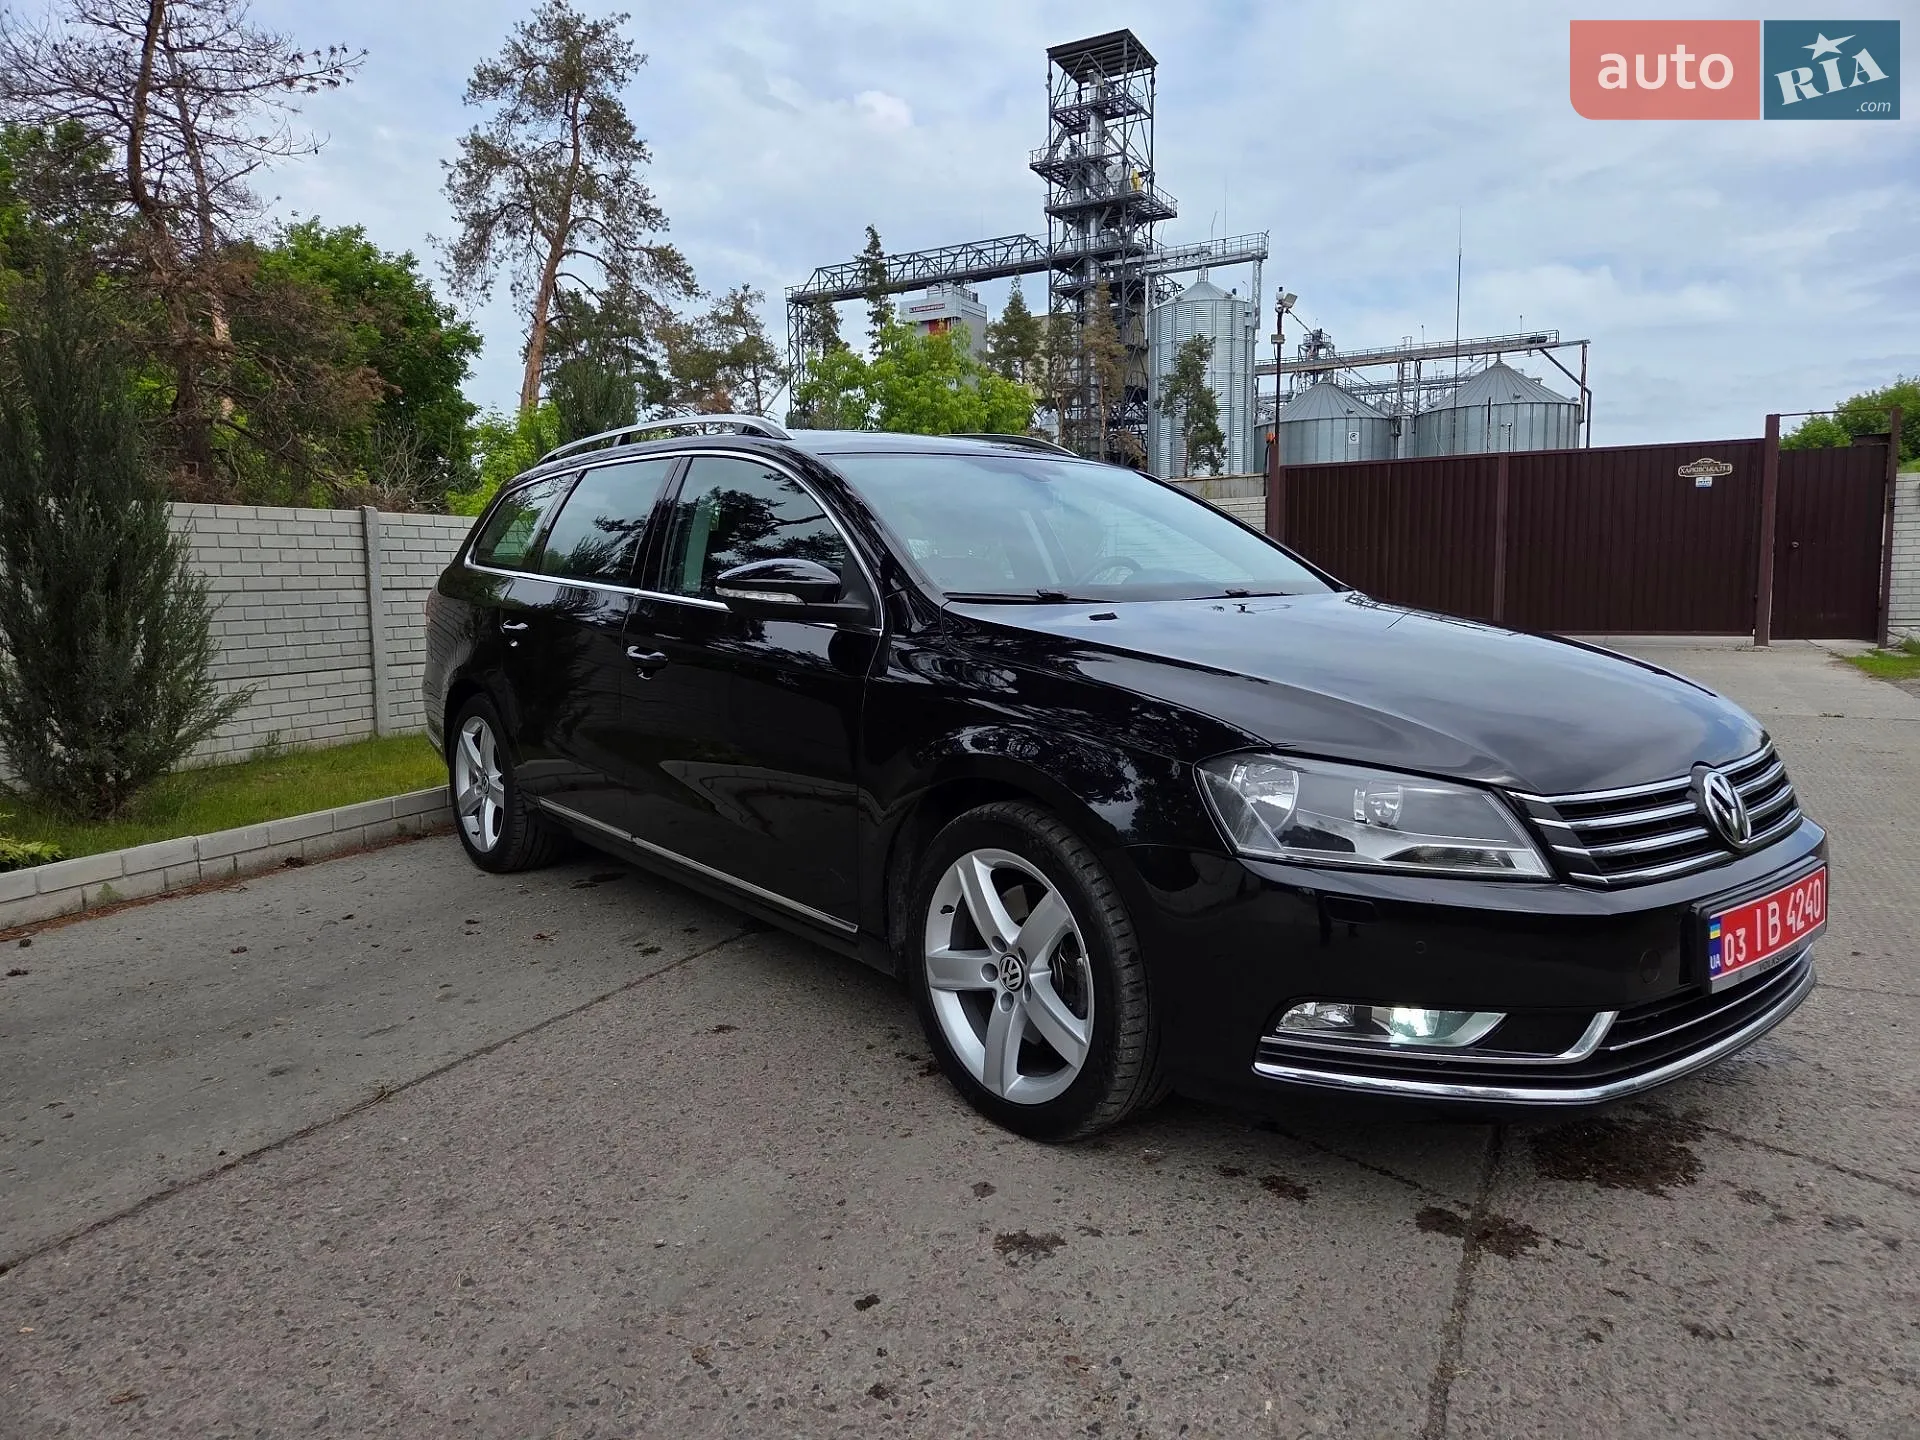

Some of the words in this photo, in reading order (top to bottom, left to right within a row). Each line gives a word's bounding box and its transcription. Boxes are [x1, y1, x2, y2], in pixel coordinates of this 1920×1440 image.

[1724, 927, 1746, 966] 03
[1786, 879, 1821, 934] 4240
[1710, 953, 1721, 969] UA
